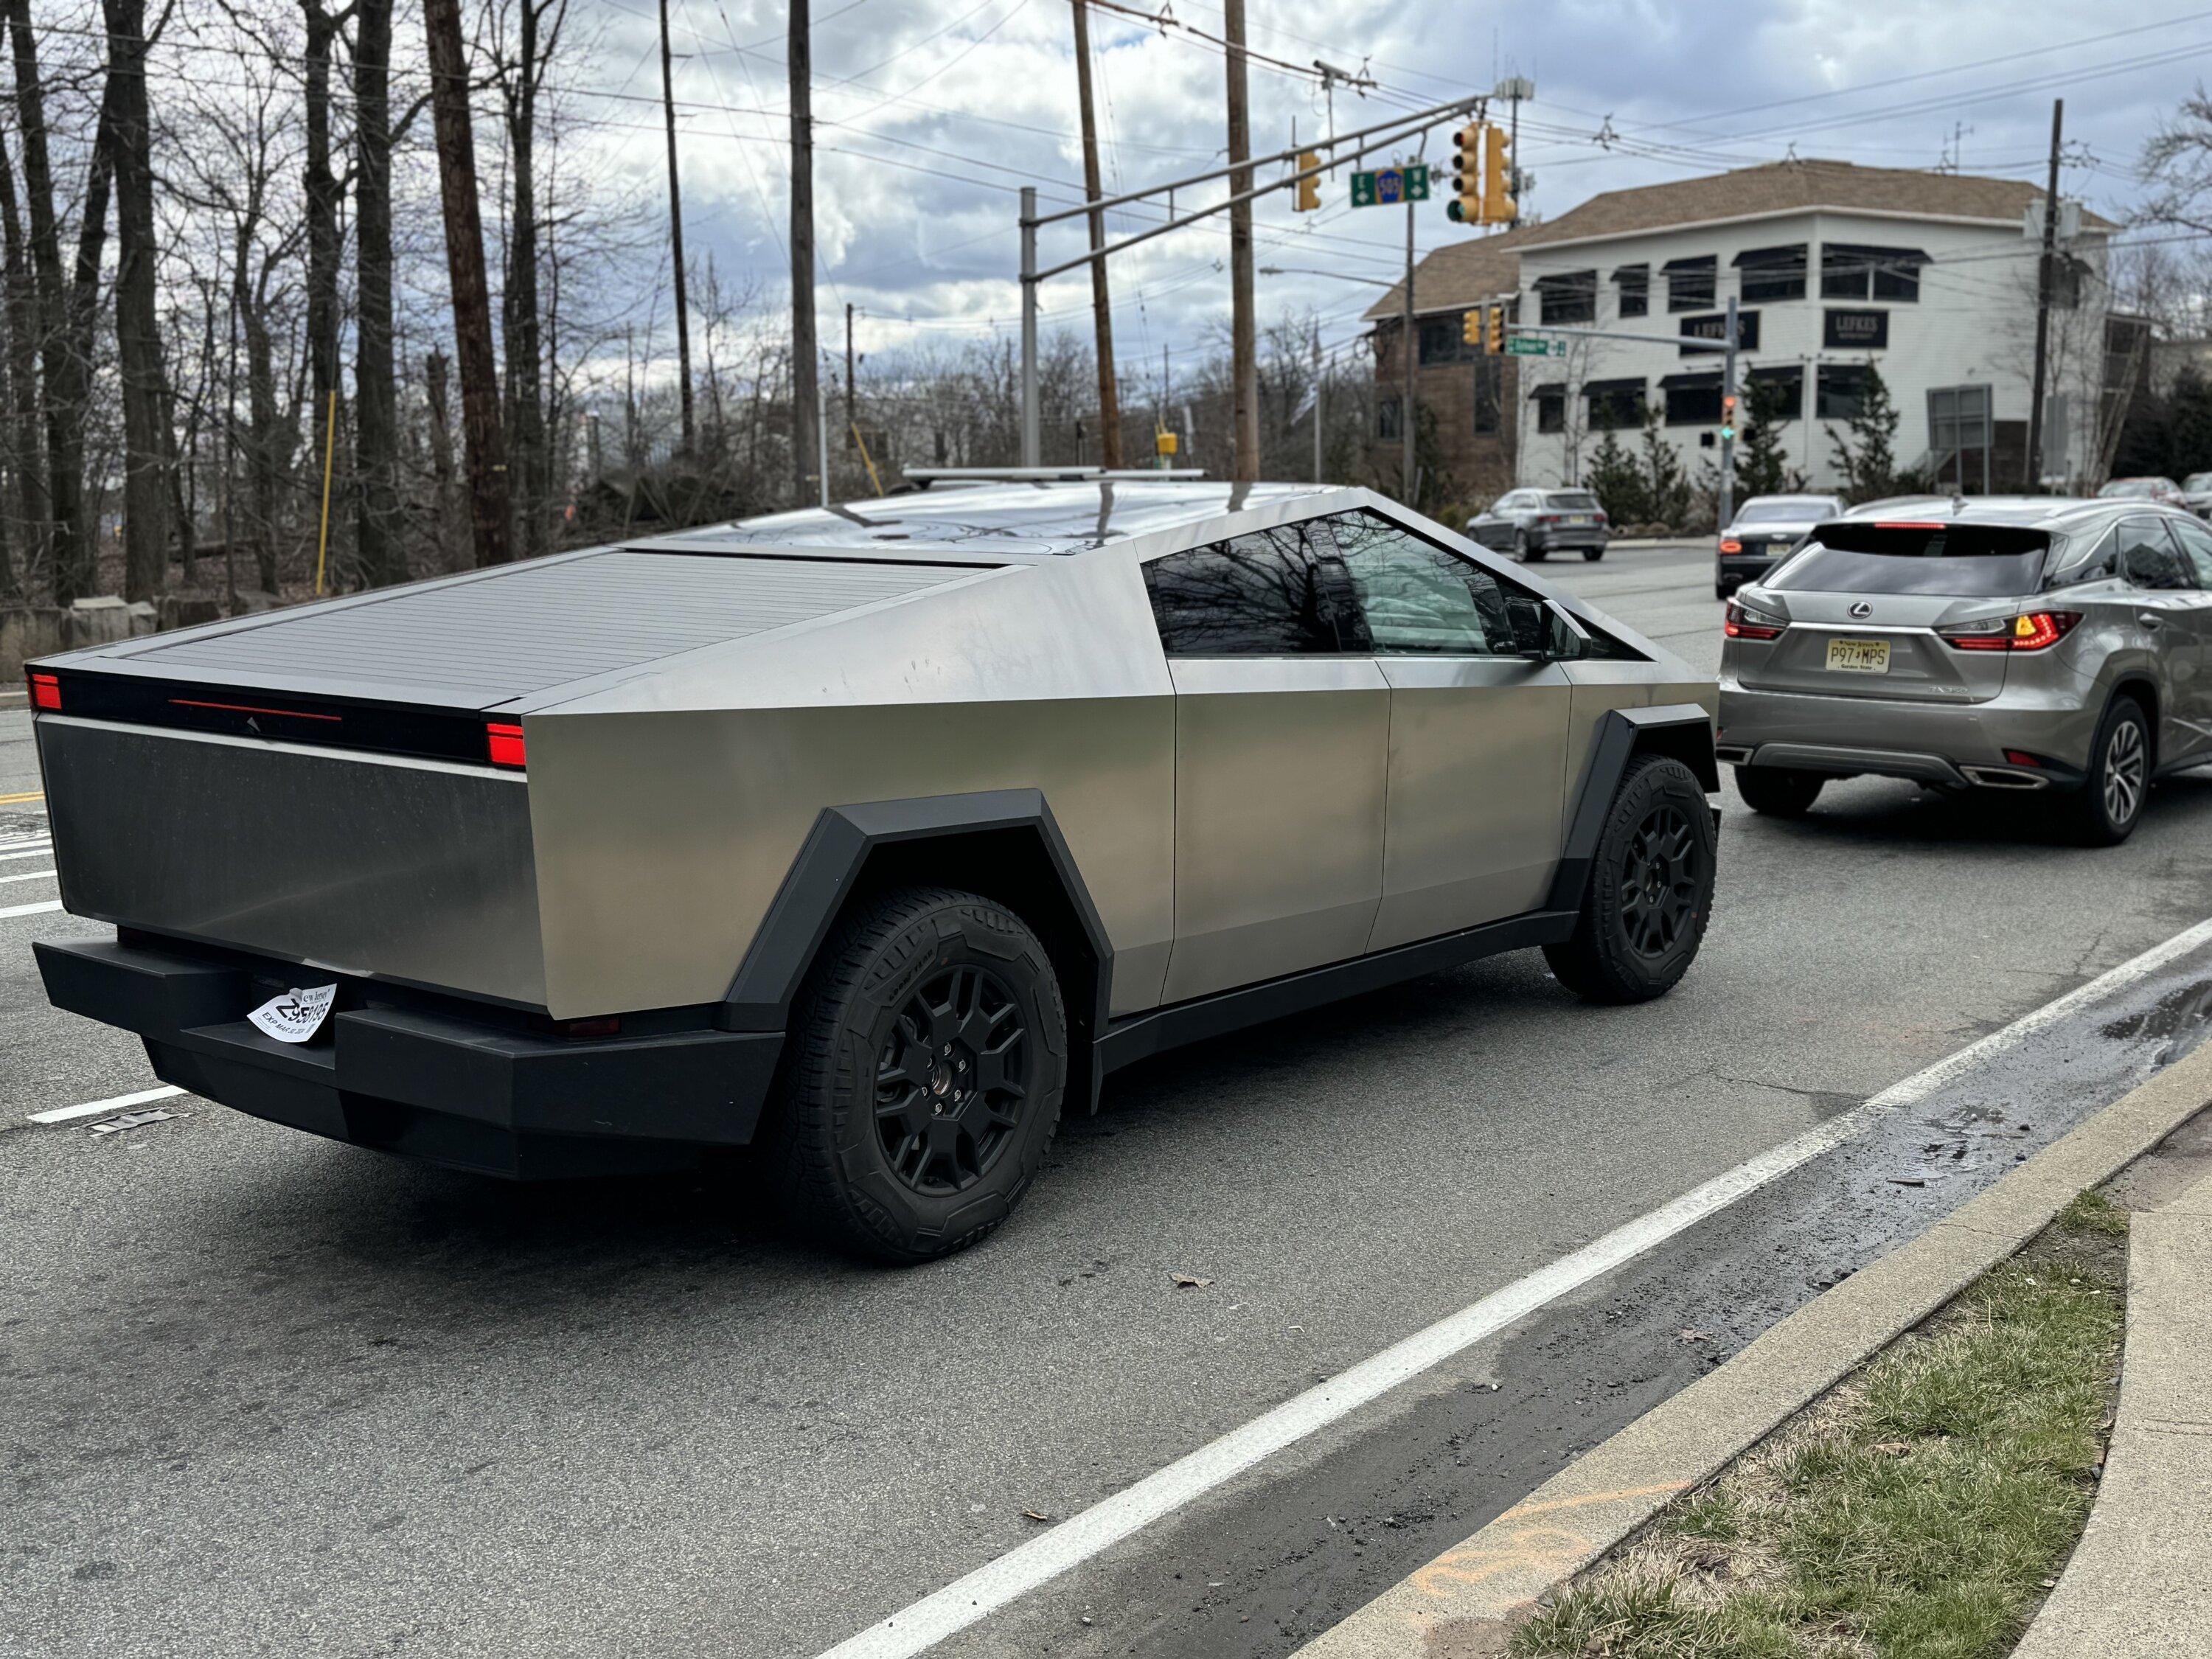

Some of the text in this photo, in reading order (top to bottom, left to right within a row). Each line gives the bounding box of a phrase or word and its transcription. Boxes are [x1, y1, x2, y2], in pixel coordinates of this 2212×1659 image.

[1836, 316, 1878, 333] LEFKES
[262, 1012, 278, 1024] EXP
[275, 1023, 291, 1033] MAR
